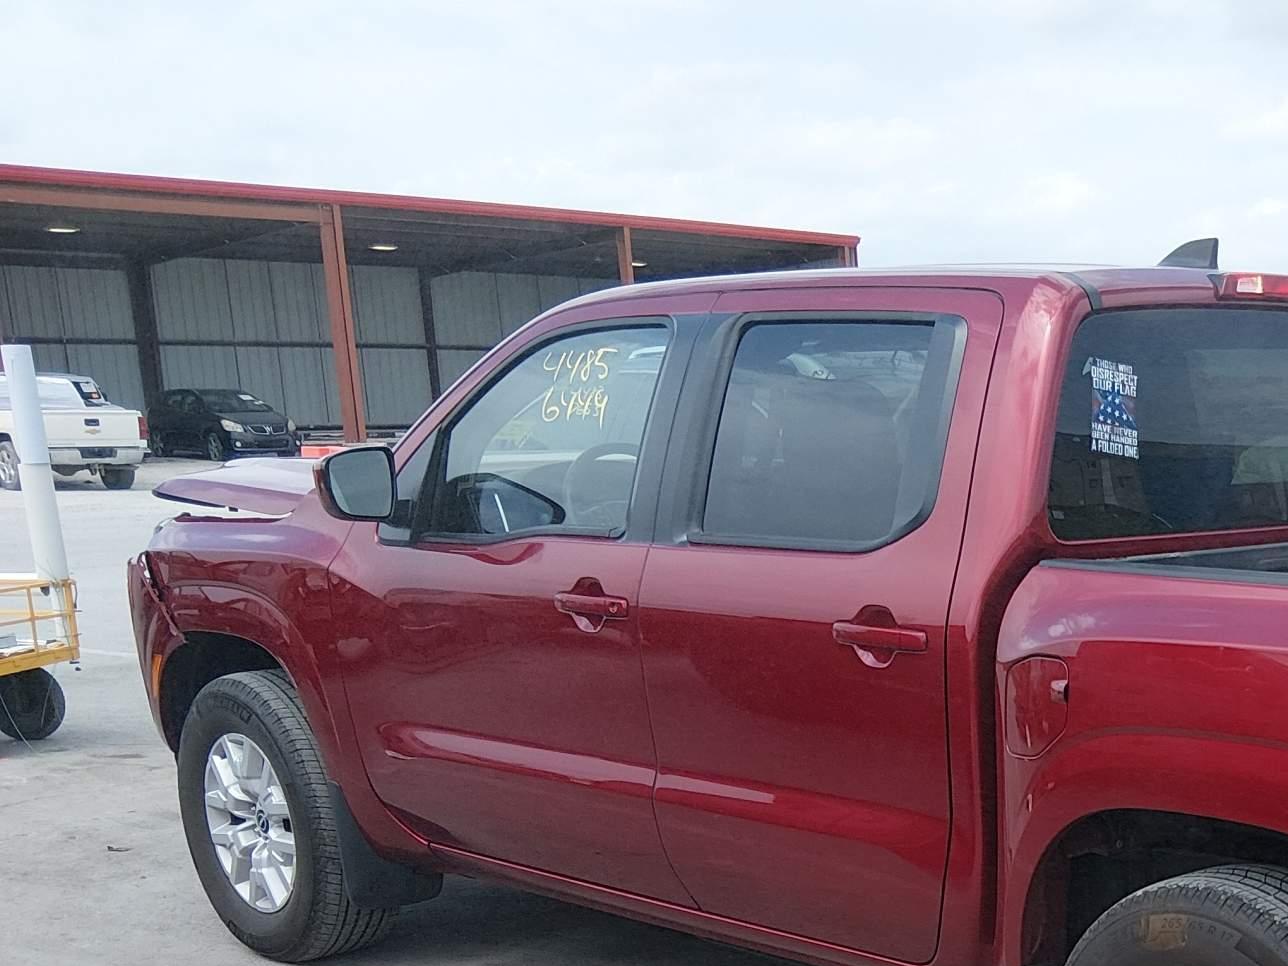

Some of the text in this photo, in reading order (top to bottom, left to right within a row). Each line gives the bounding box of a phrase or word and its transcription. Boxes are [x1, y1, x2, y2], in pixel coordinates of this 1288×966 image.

[543, 348, 619, 384] 4485
[1118, 362, 1133, 375] WHO
[1091, 365, 1138, 387] DISRESPECT
[1092, 377, 1137, 398] OUR FLAG
[541, 387, 609, 429] 6449
[1091, 421, 1138, 439] HAVE NEVER
[1091, 430, 1138, 446] BEEN HANDED
[1091, 438, 1097, 451] A
[1097, 440, 1124, 456] FOLDED
